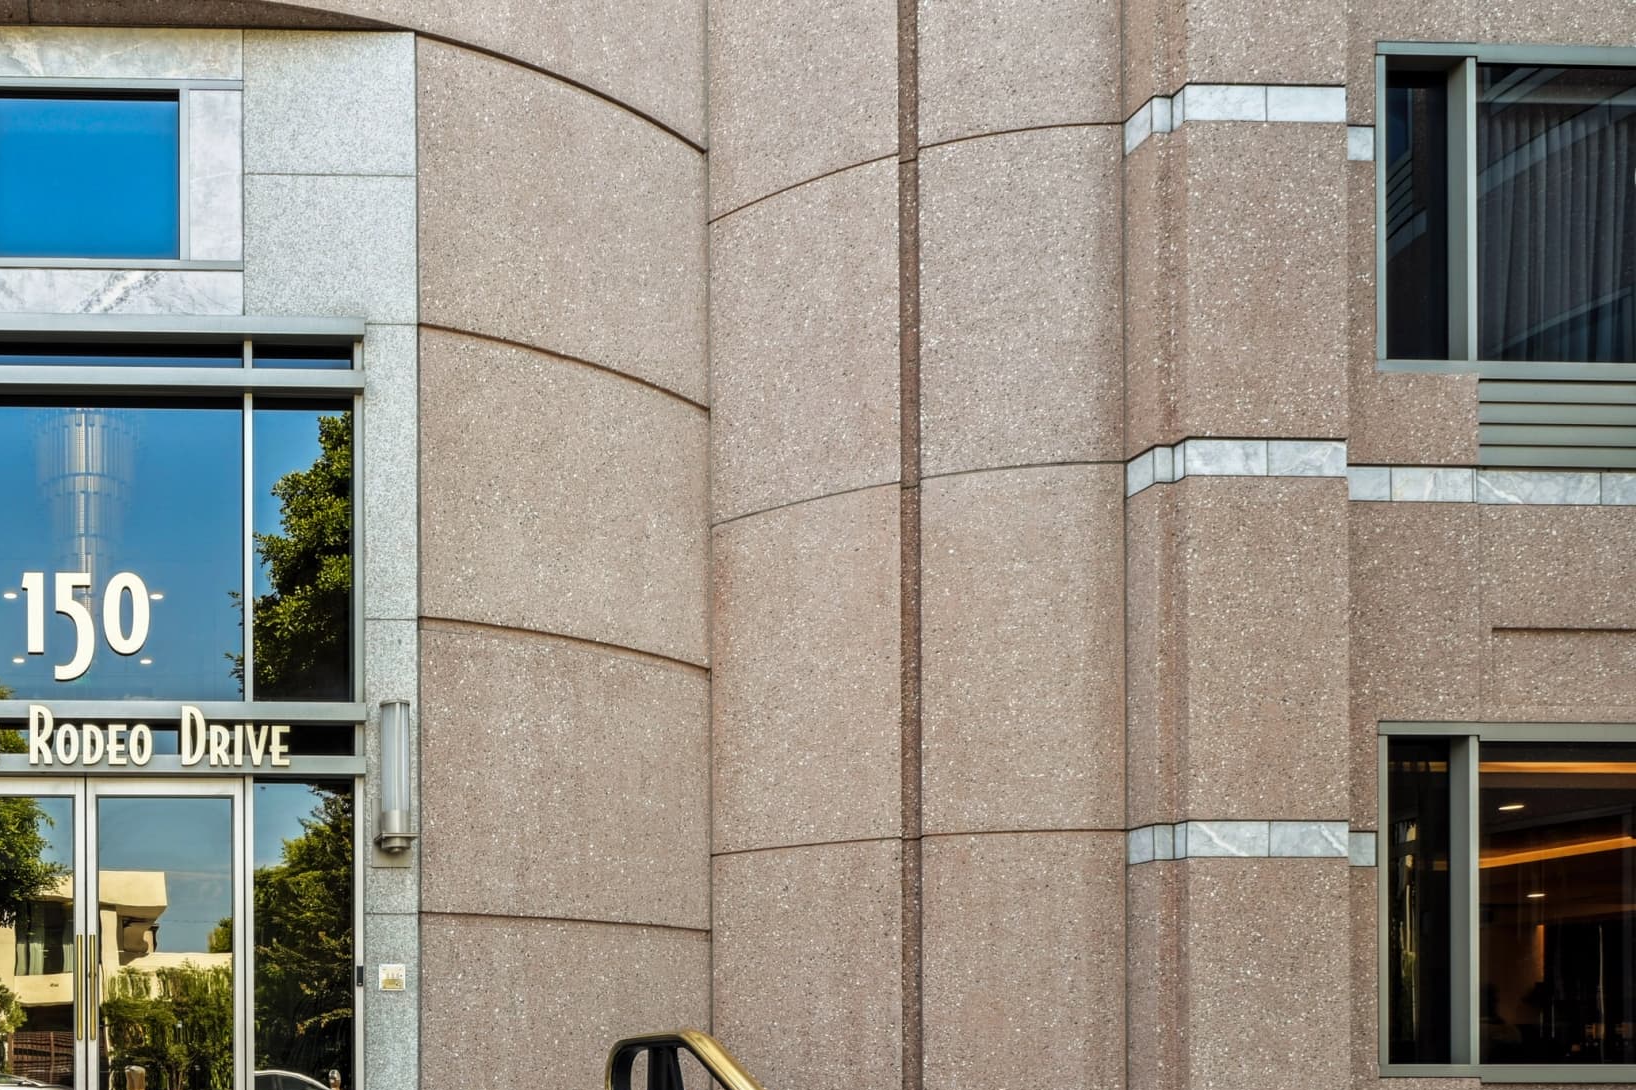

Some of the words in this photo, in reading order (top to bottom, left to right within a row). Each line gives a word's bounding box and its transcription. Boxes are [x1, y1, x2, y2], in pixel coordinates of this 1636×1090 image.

[21, 571, 151, 682] 150
[28, 704, 153, 767] RODEO
[180, 705, 291, 768] DRIVE
